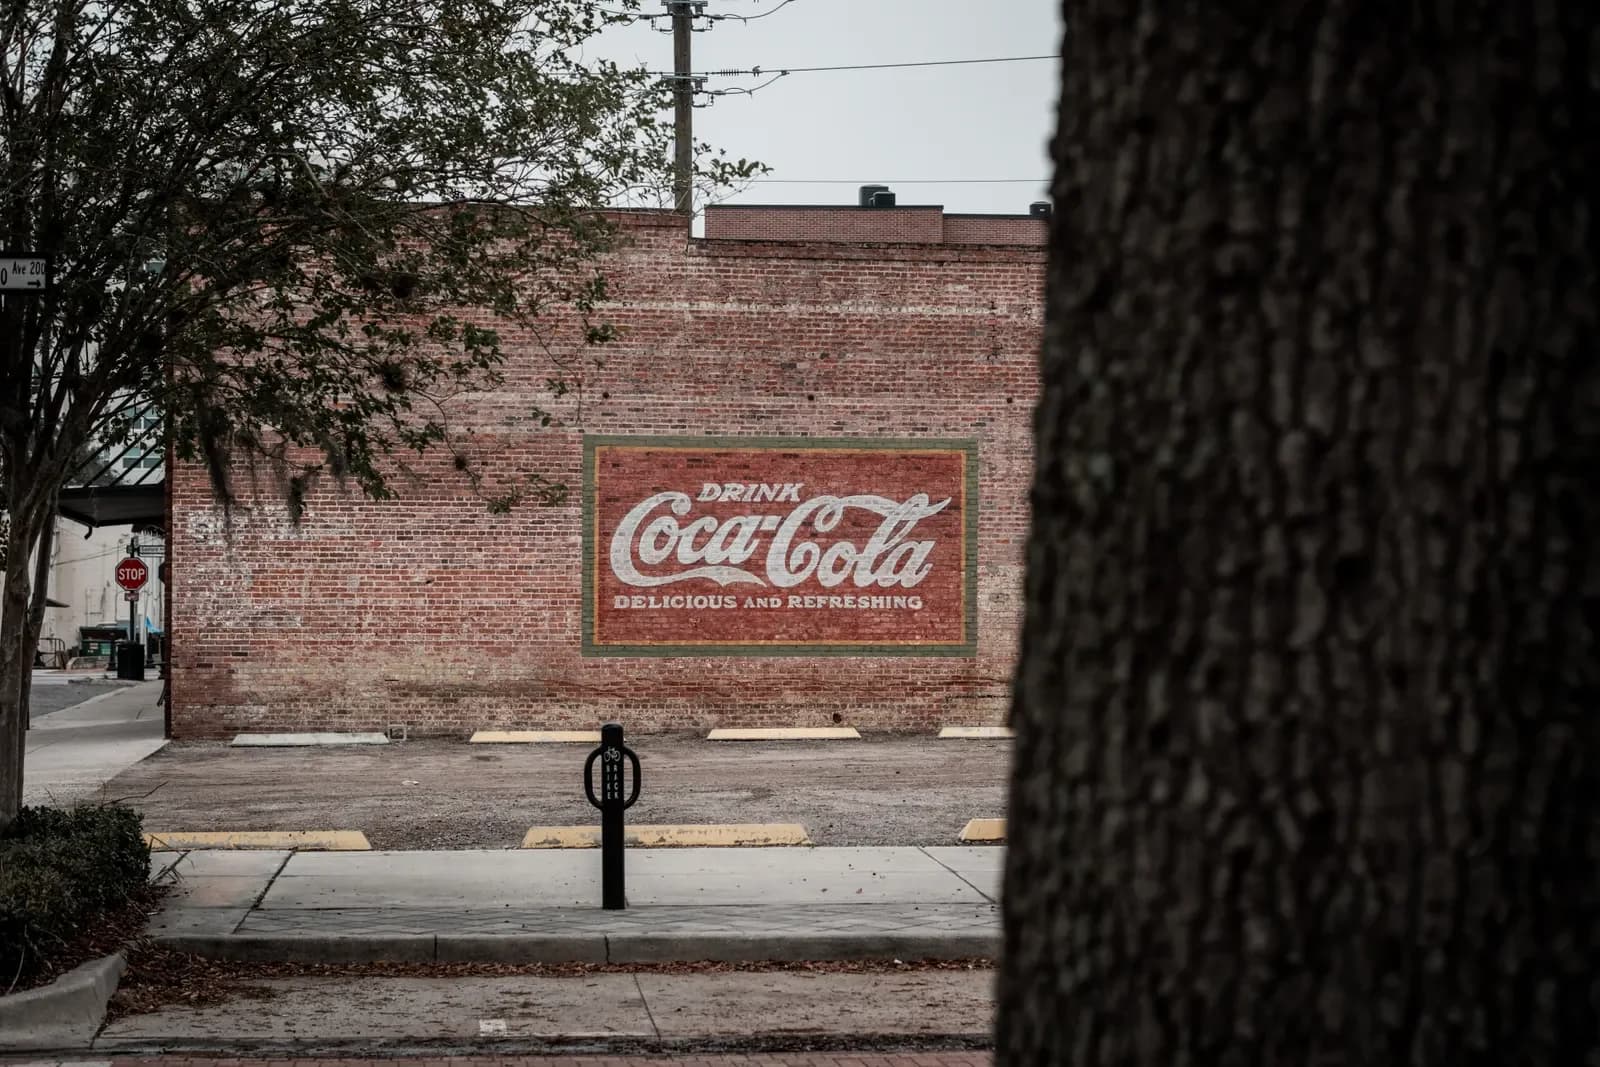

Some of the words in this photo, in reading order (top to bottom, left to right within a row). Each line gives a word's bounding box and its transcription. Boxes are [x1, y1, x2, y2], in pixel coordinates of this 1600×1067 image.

[12, 261, 26, 275] Ave
[30, 261, 45, 275] 200
[697, 482, 805, 502] DRINK
[609, 490, 952, 589] Coca-Cola
[118, 568, 145, 581] STOP
[613, 595, 737, 609] DELICIOUS
[743, 597, 782, 609] AND
[788, 595, 923, 609] REFRESHING
